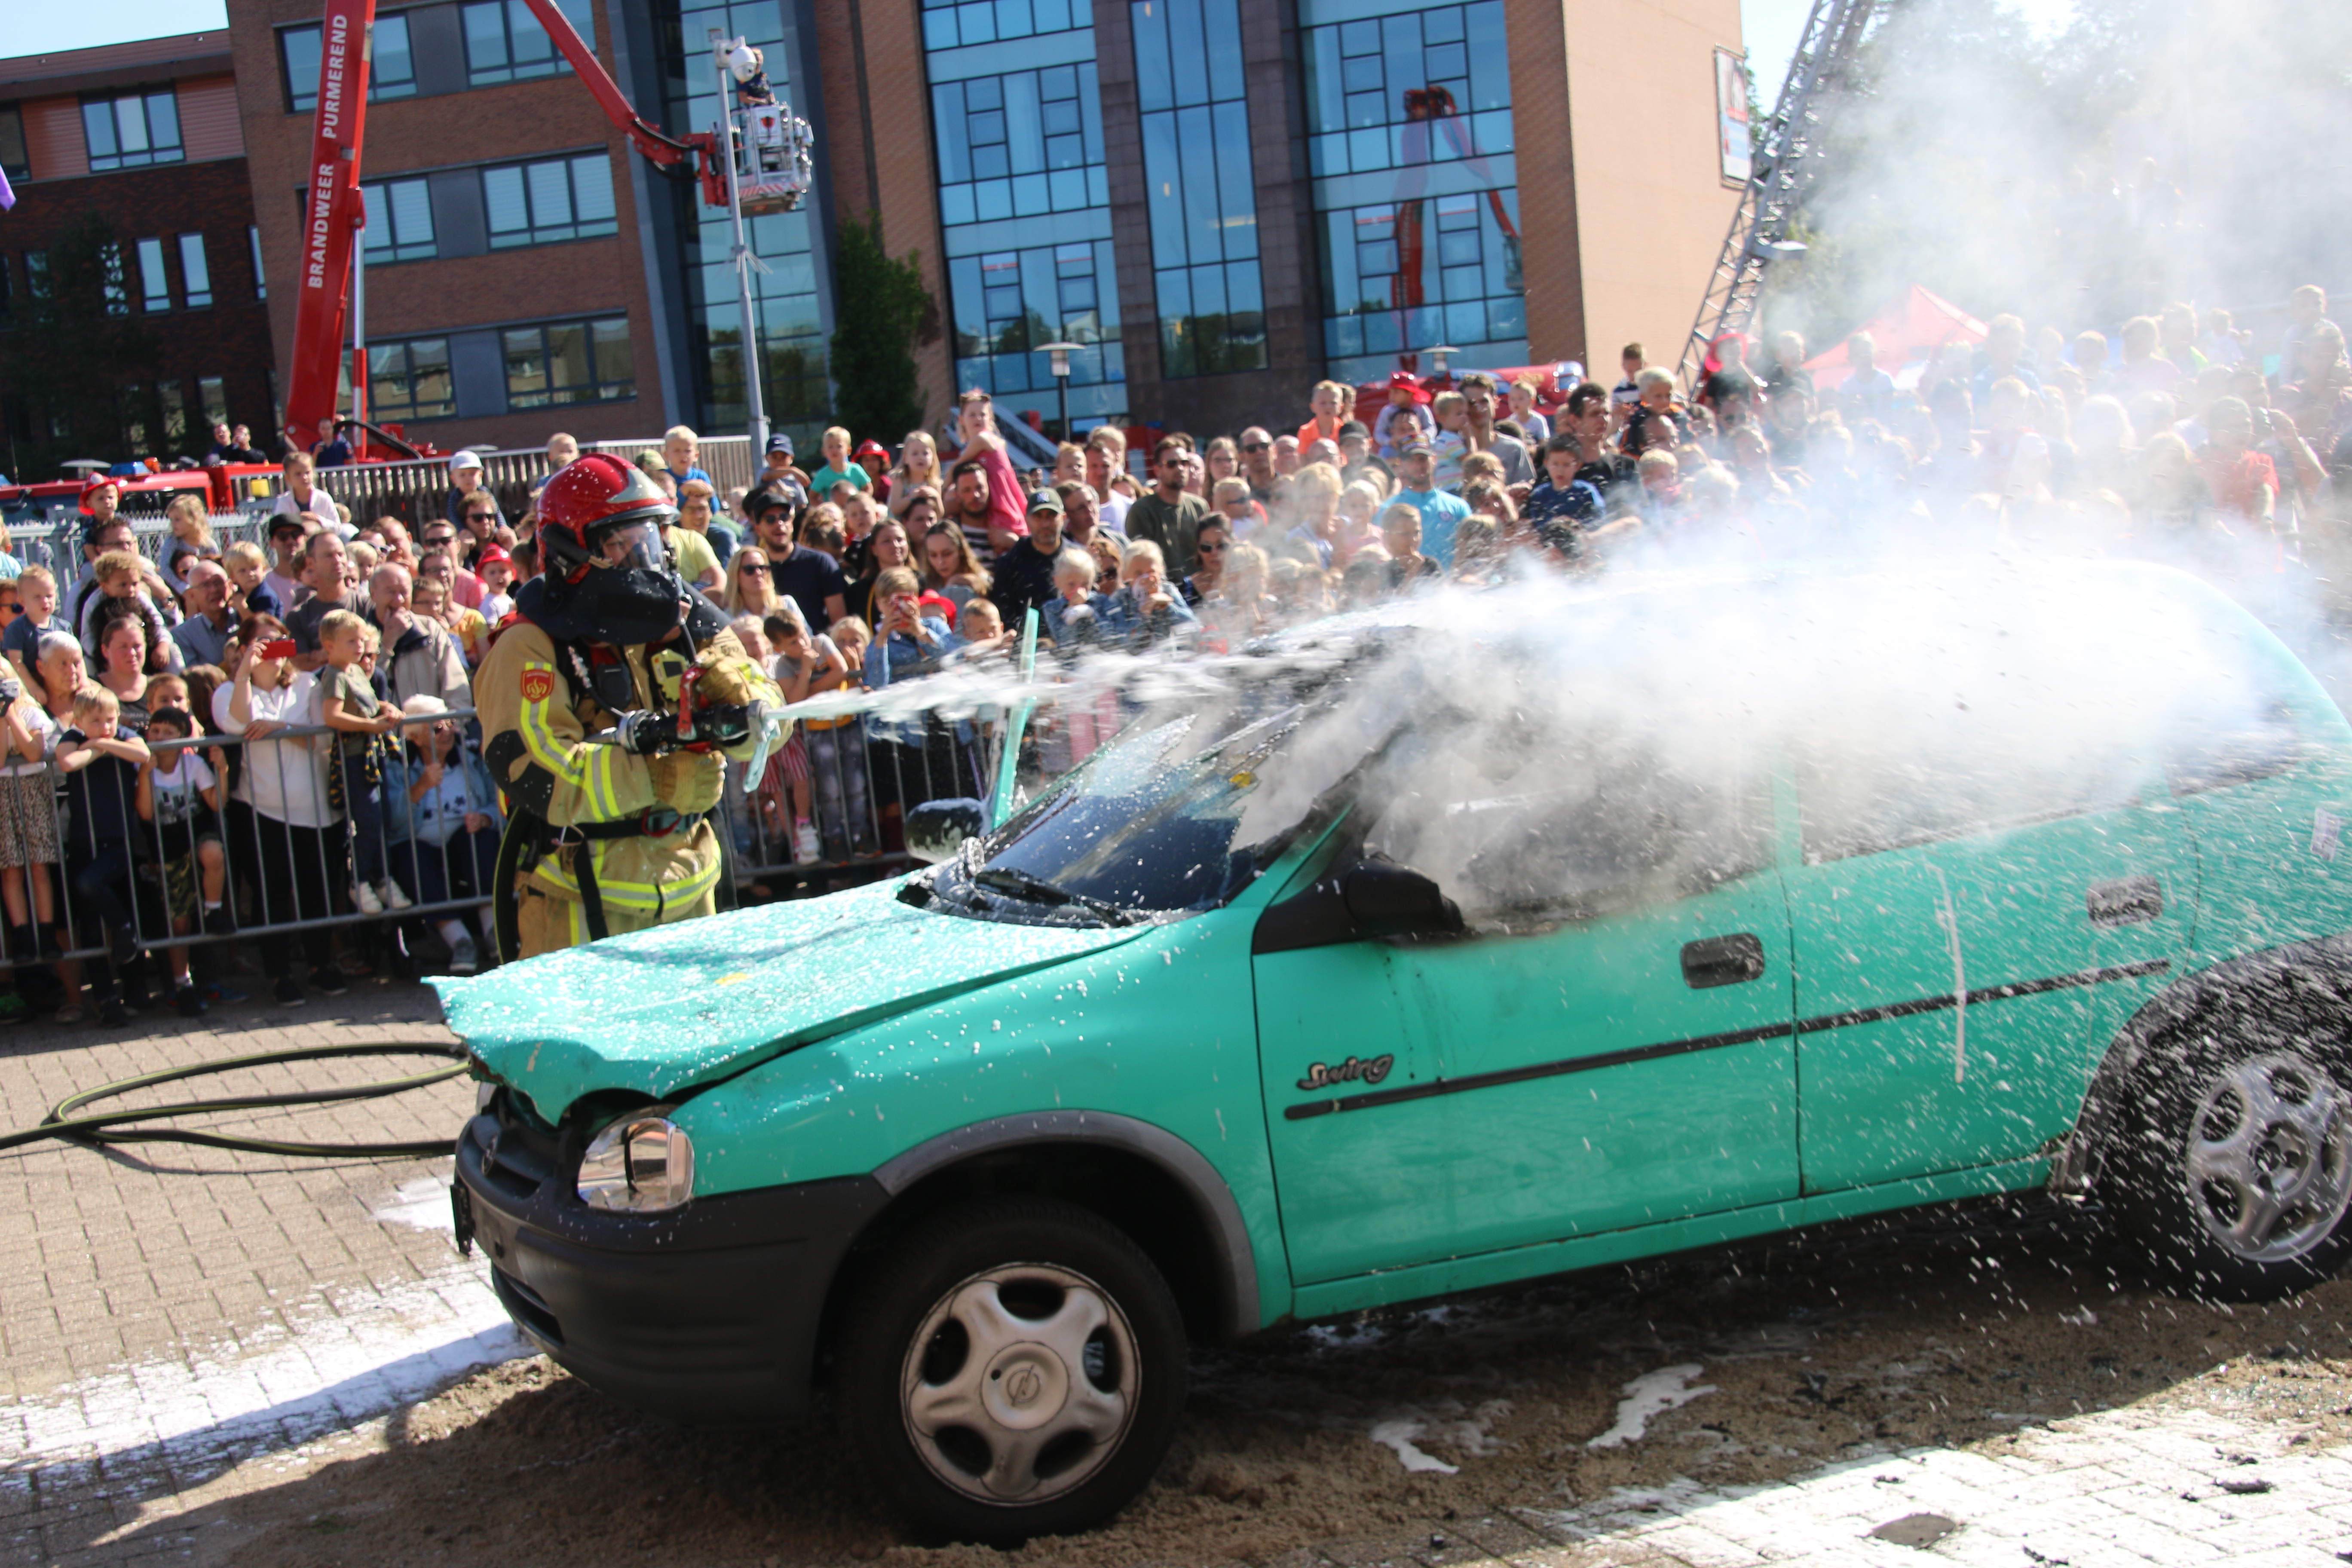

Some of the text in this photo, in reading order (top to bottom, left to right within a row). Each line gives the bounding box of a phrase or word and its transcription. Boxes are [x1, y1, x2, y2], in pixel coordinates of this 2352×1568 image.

[308, 14, 348, 288] BRANDWEER PURMEREND
[1296, 1053, 1394, 1090] Swing
